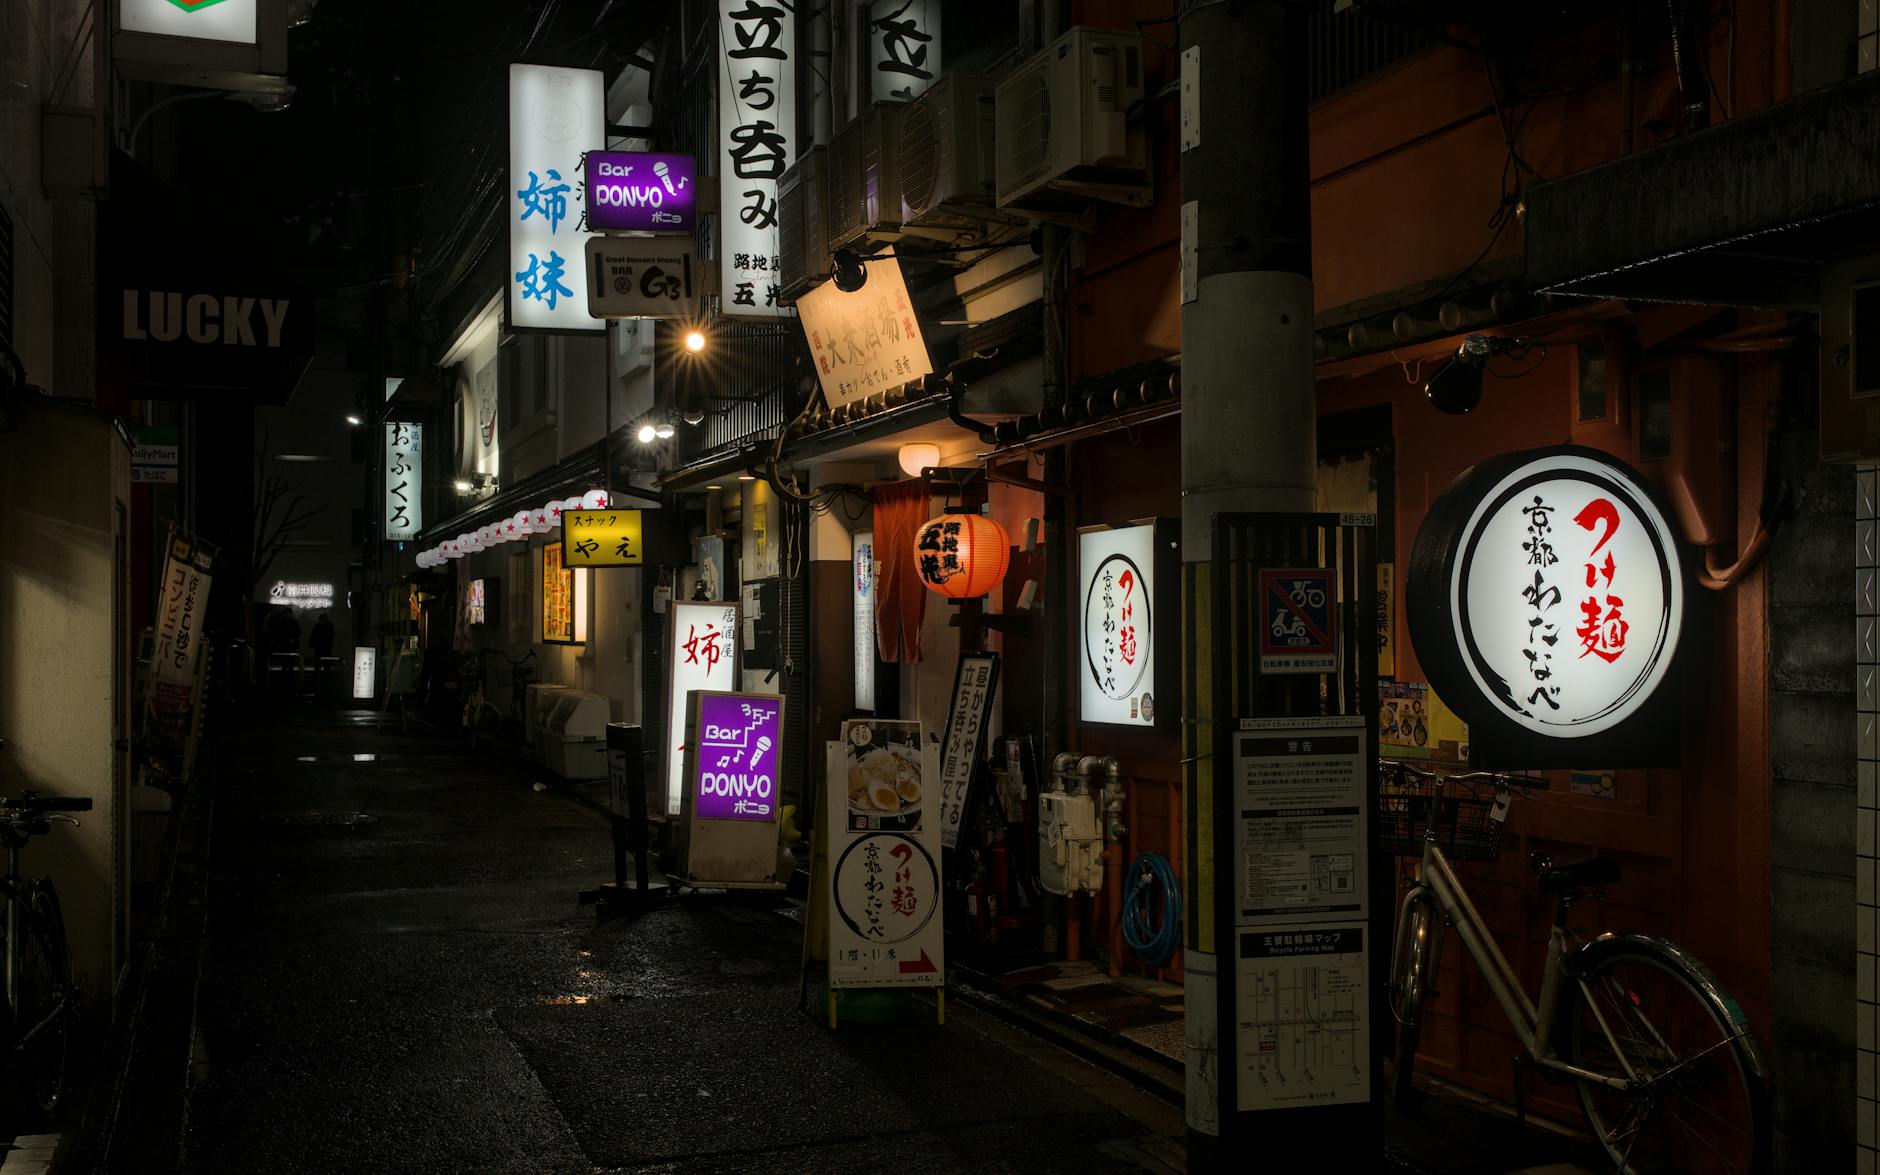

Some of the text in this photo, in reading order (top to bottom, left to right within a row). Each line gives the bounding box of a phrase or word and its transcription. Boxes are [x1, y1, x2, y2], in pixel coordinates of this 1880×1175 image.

[728, 2, 788, 230] 立ち呑み
[595, 184, 663, 207] PONYO
[598, 162, 634, 177] Bar
[516, 170, 573, 310] 姉妹
[611, 266, 632, 275] BAR
[123, 289, 290, 348] LUCKY
[390, 421, 411, 528] おふくろ
[574, 515, 617, 527] スナック
[574, 536, 637, 558] やえ
[1522, 496, 1562, 711] 京都わたなべ
[1572, 498, 1629, 664] つけ麺
[720, 608, 736, 657] 居酒屋
[1102, 570, 1115, 691] 京都わたなべ
[1118, 569, 1137, 665] つけ麺
[705, 724, 742, 740] Bar
[741, 704, 764, 721] 3F
[701, 772, 771, 798] PONYO
[864, 842, 885, 937] 京都わたなべ
[889, 843, 918, 917] つけ麺
